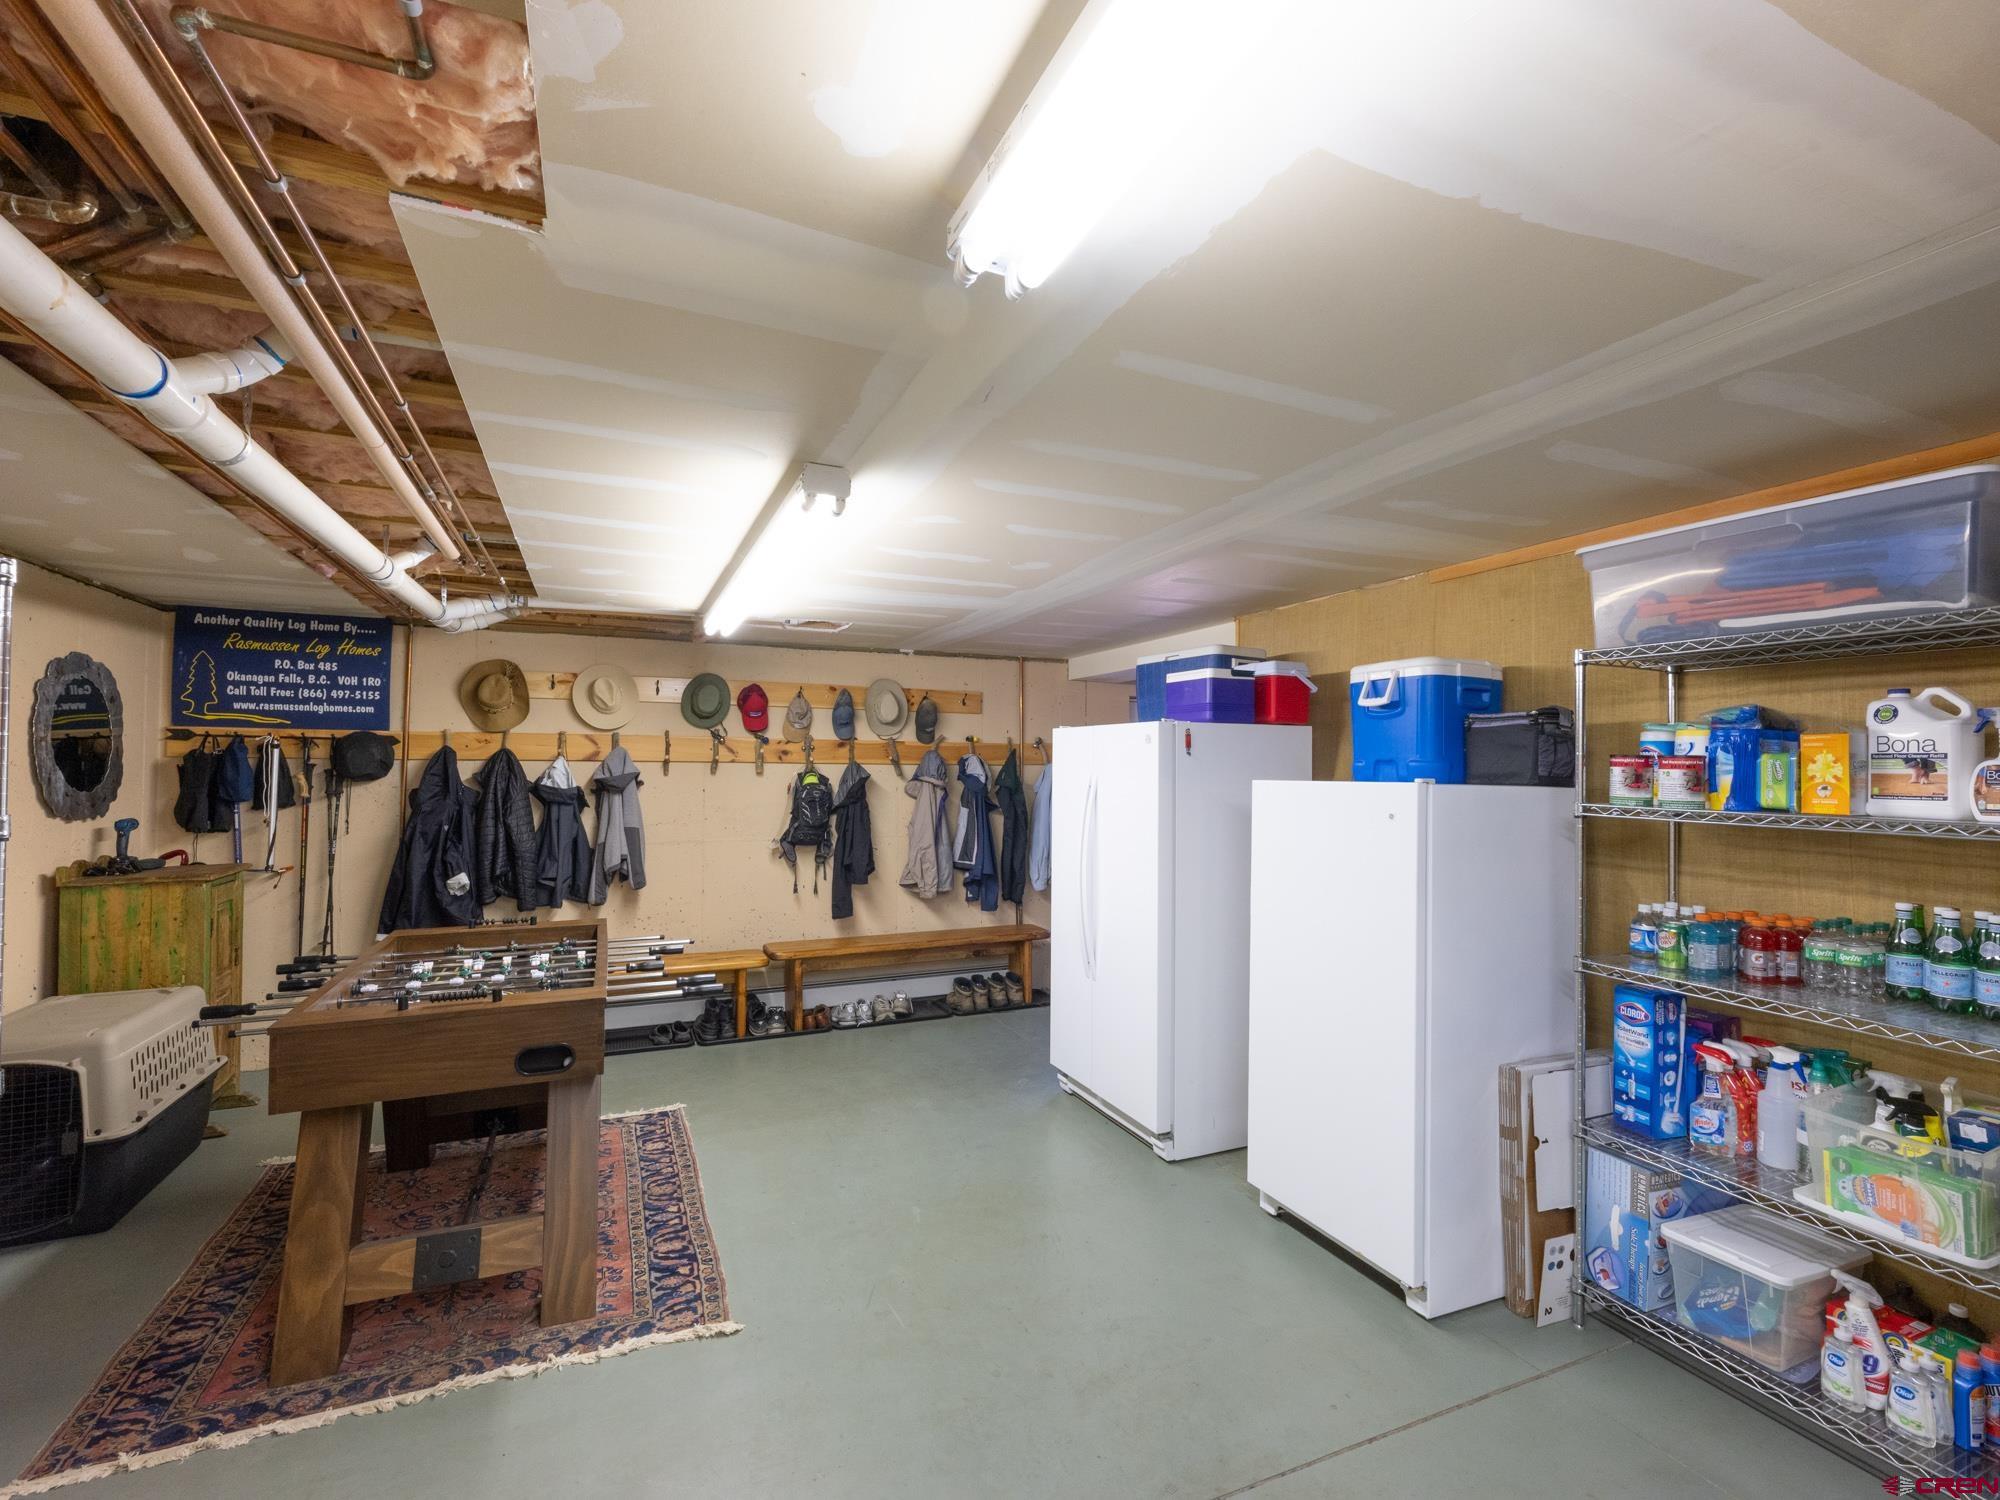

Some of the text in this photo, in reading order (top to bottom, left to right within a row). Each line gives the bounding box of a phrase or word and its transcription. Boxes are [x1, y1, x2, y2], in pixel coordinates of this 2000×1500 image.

[194, 612, 240, 627] Another
[243, 616, 285, 631] Quality
[288, 619, 306, 632] Log
[310, 621, 340, 633] Home
[222, 632, 382, 659] Rasmussen Log Homes
[274, 659, 338, 671] P.O. Box 485
[226, 671, 275, 684] Okanagan
[278, 672, 305, 685] Falls,
[308, 674, 331, 685] B.C.
[226, 685, 381, 700] Call Toll Free: (866) 497-5155
[233, 701, 374, 714] www.rasmussenloghomes.com
[1876, 735, 1937, 753] Bona
[1838, 953, 1863, 962] Sprite
[1620, 1006, 1646, 1021] CLOROX
[1544, 1306, 1553, 1316] 2
[1829, 1354, 1844, 1366] Dial
[1895, 1386, 1914, 1399] Dial
